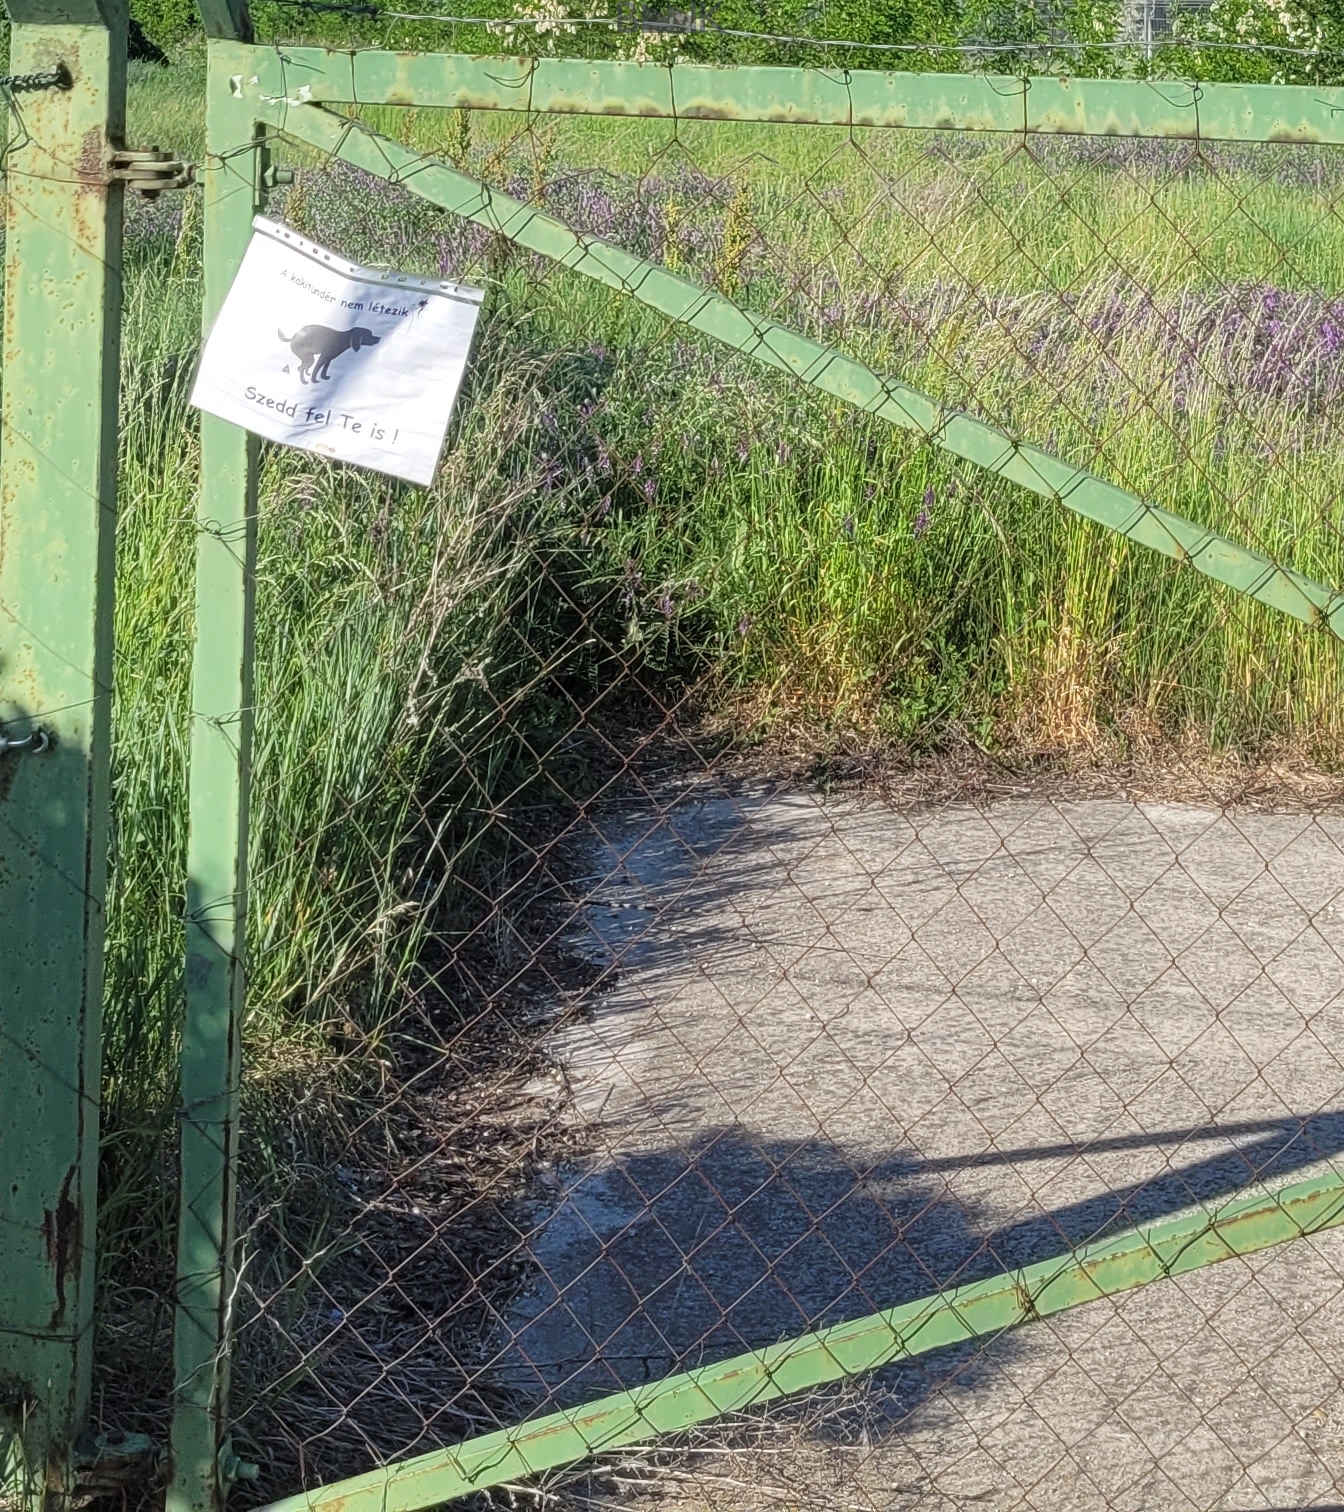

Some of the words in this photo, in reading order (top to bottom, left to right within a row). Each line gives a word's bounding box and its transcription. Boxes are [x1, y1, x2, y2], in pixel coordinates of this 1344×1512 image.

[280, 269, 288, 277] A
[340, 299, 364, 311] nem
[368, 301, 409, 317] létezik
[244, 386, 298, 418] Szedd
[305, 406, 332, 425] fel
[340, 413, 362, 433] Te
[370, 422, 386, 441] is
